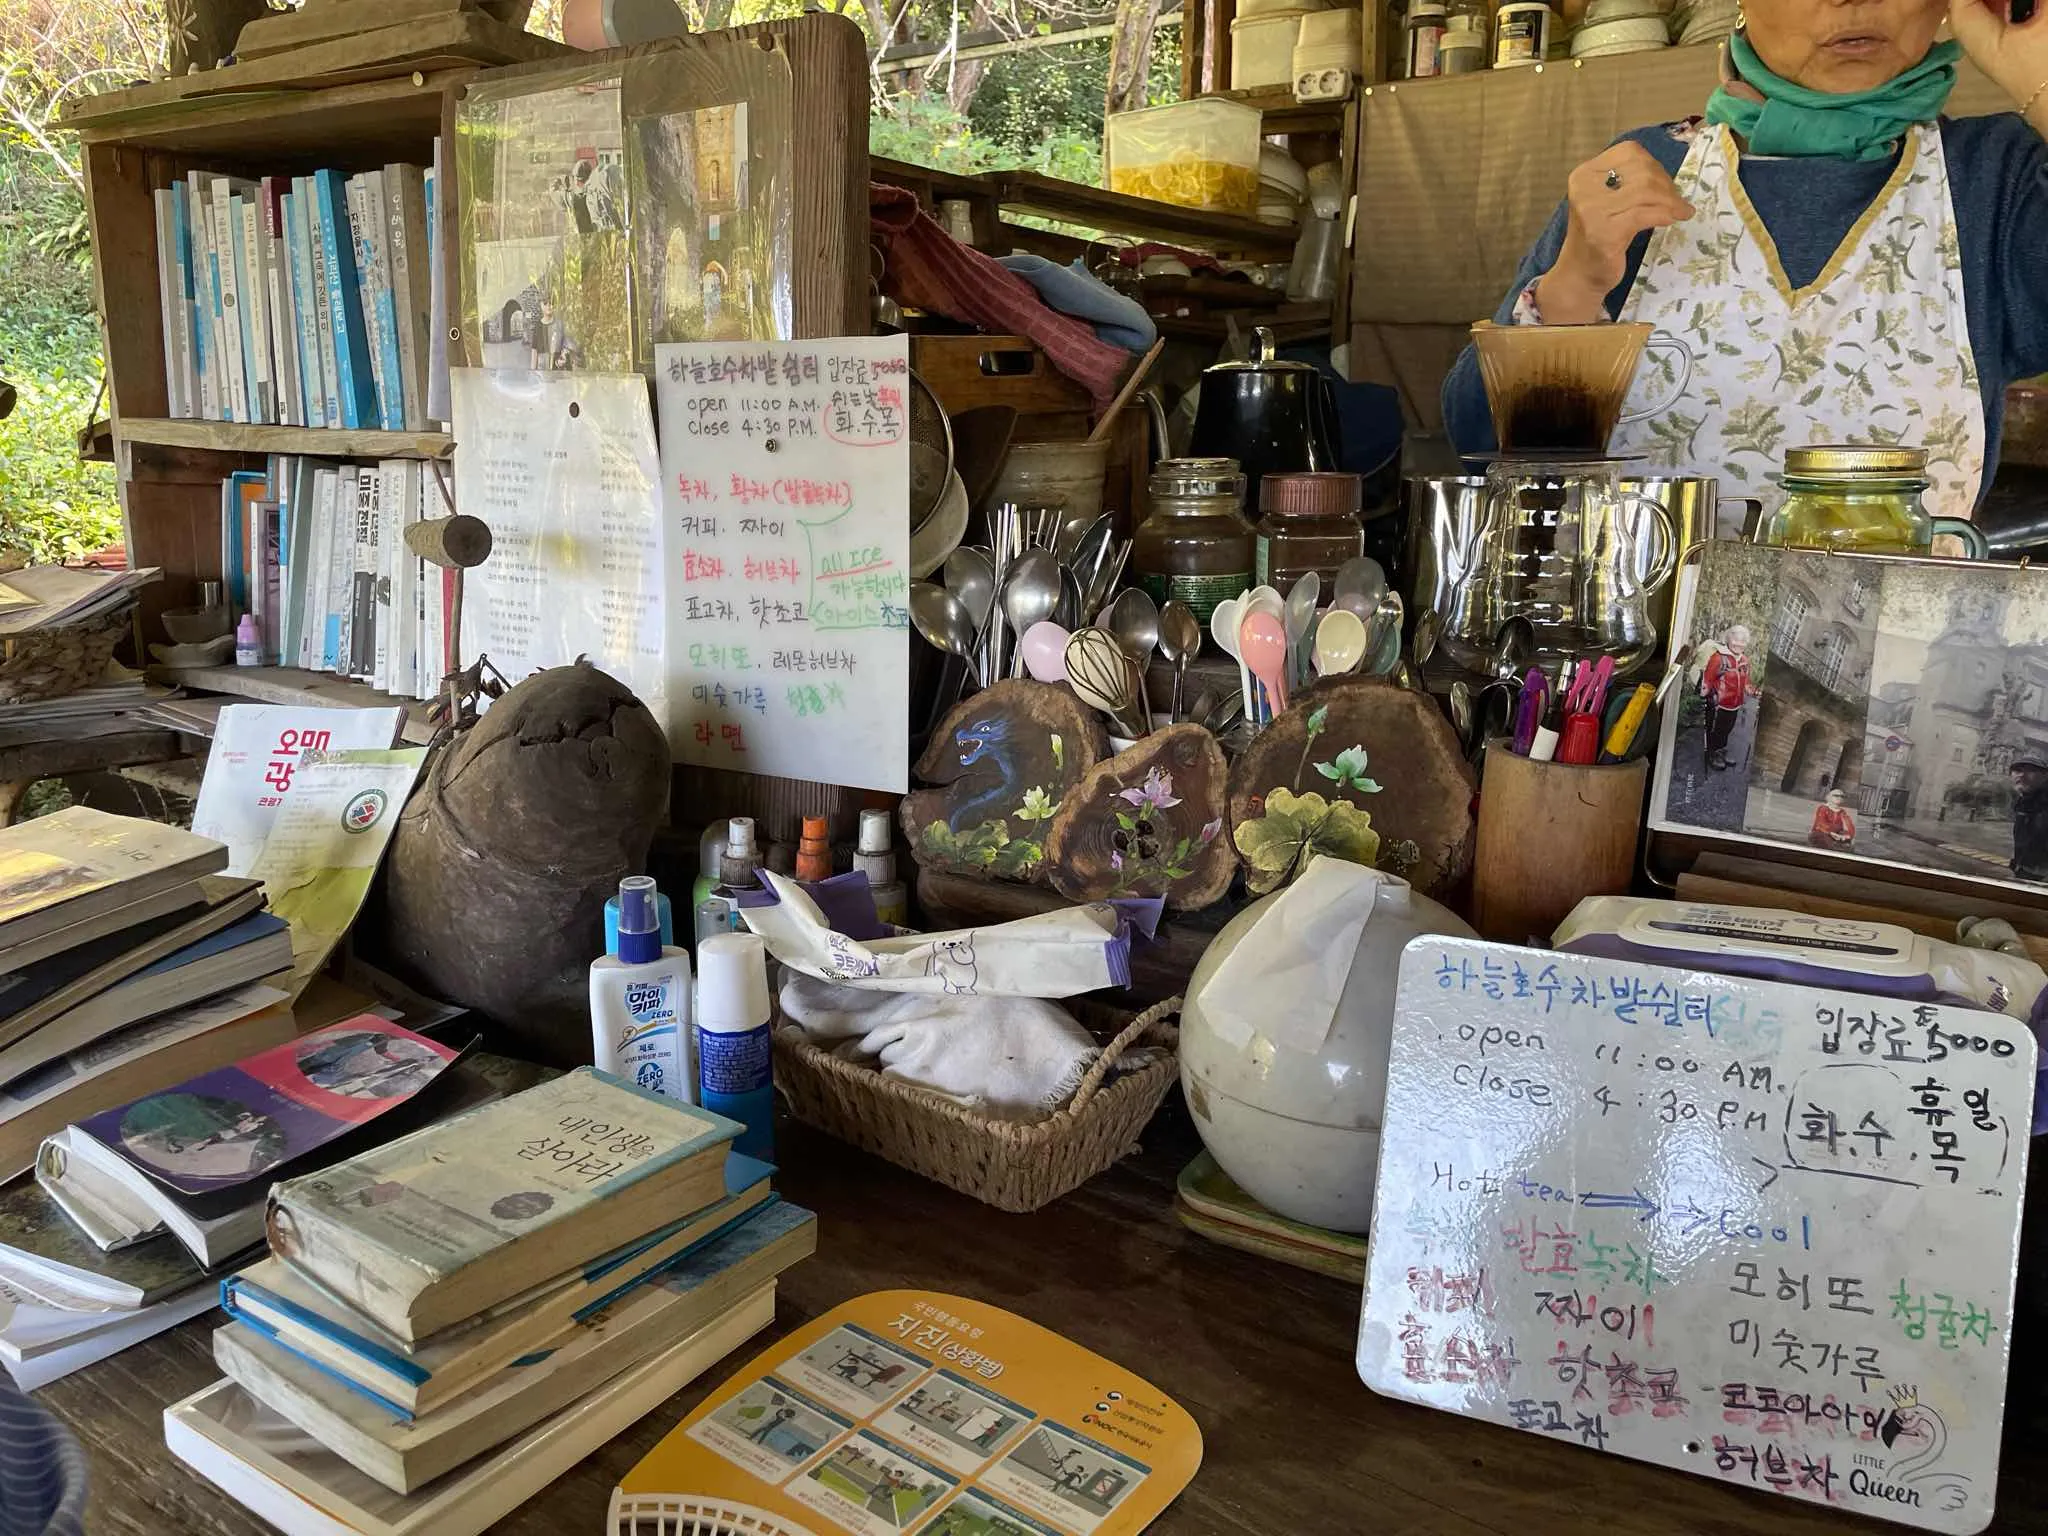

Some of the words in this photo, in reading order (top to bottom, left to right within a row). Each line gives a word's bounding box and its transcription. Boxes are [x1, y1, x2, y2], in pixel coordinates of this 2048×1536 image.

[828, 356, 870, 386] 입장료
[688, 397, 728, 417] open
[741, 398, 781, 412] 11:00
[788, 398, 821, 413] A.M.
[688, 419, 730, 436] Close
[742, 418, 781, 437] 4:30
[788, 419, 818, 438] P.M.
[740, 517, 784, 537] 짜이
[744, 554, 801, 584] 허브차
[748, 594, 809, 628] 핫초코
[772, 649, 857, 675] 레몬허브차
[692, 682, 768, 715] 미숫가루
[694, 720, 748, 751] 라면
[651, 1009, 673, 1019] ZERO
[1458, 1023, 1545, 1056] open
[1815, 1001, 1928, 1064] 입장료
[1925, 1023, 2016, 1062] 5000
[636, 1068, 664, 1086] ZERO
[1453, 1063, 1553, 1107] Close
[1593, 1085, 1699, 1124] 4:30
[517, 1136, 625, 1184] 살아라
[1515, 1171, 1574, 1203] tea
[1719, 1207, 1811, 1250] Cool
[1729, 1261, 1875, 1315] 모히또
[1888, 1277, 1998, 1350] 청귤차
[1728, 1318, 1886, 1394] 미숫가루
[1714, 1434, 1841, 1501] 허브차
[1853, 1454, 1888, 1472] LITTLE
[1850, 1470, 1924, 1510] Queen
